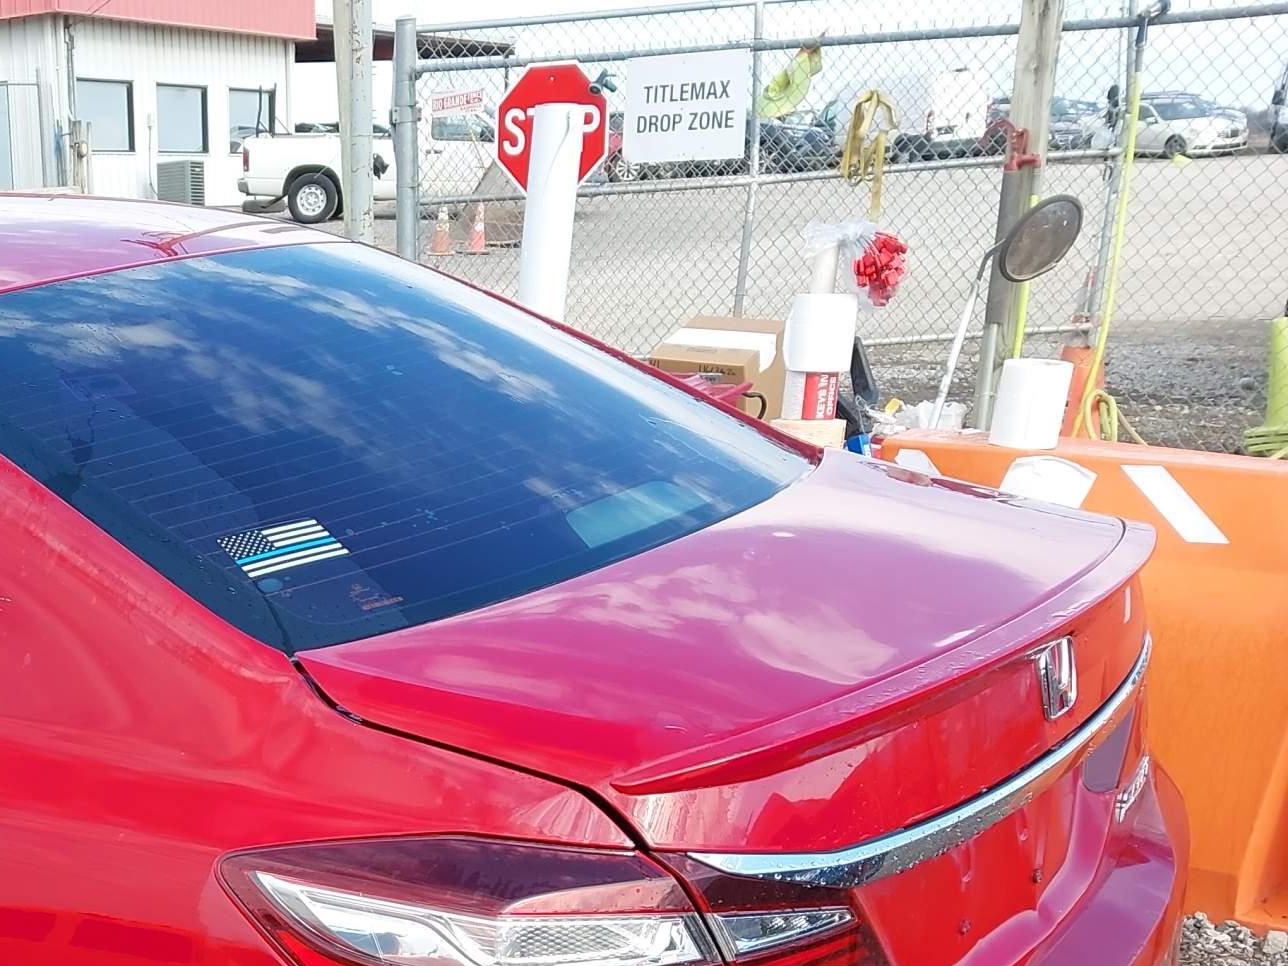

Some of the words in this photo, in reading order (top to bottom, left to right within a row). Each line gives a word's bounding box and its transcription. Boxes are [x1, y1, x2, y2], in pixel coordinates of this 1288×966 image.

[644, 79, 730, 104] TITLEMAX
[503, 104, 601, 156] SP
[636, 113, 683, 133] DROP
[688, 109, 735, 131] ZONE
[815, 388, 827, 419] KEYS
[826, 376, 837, 416] OFFICE
